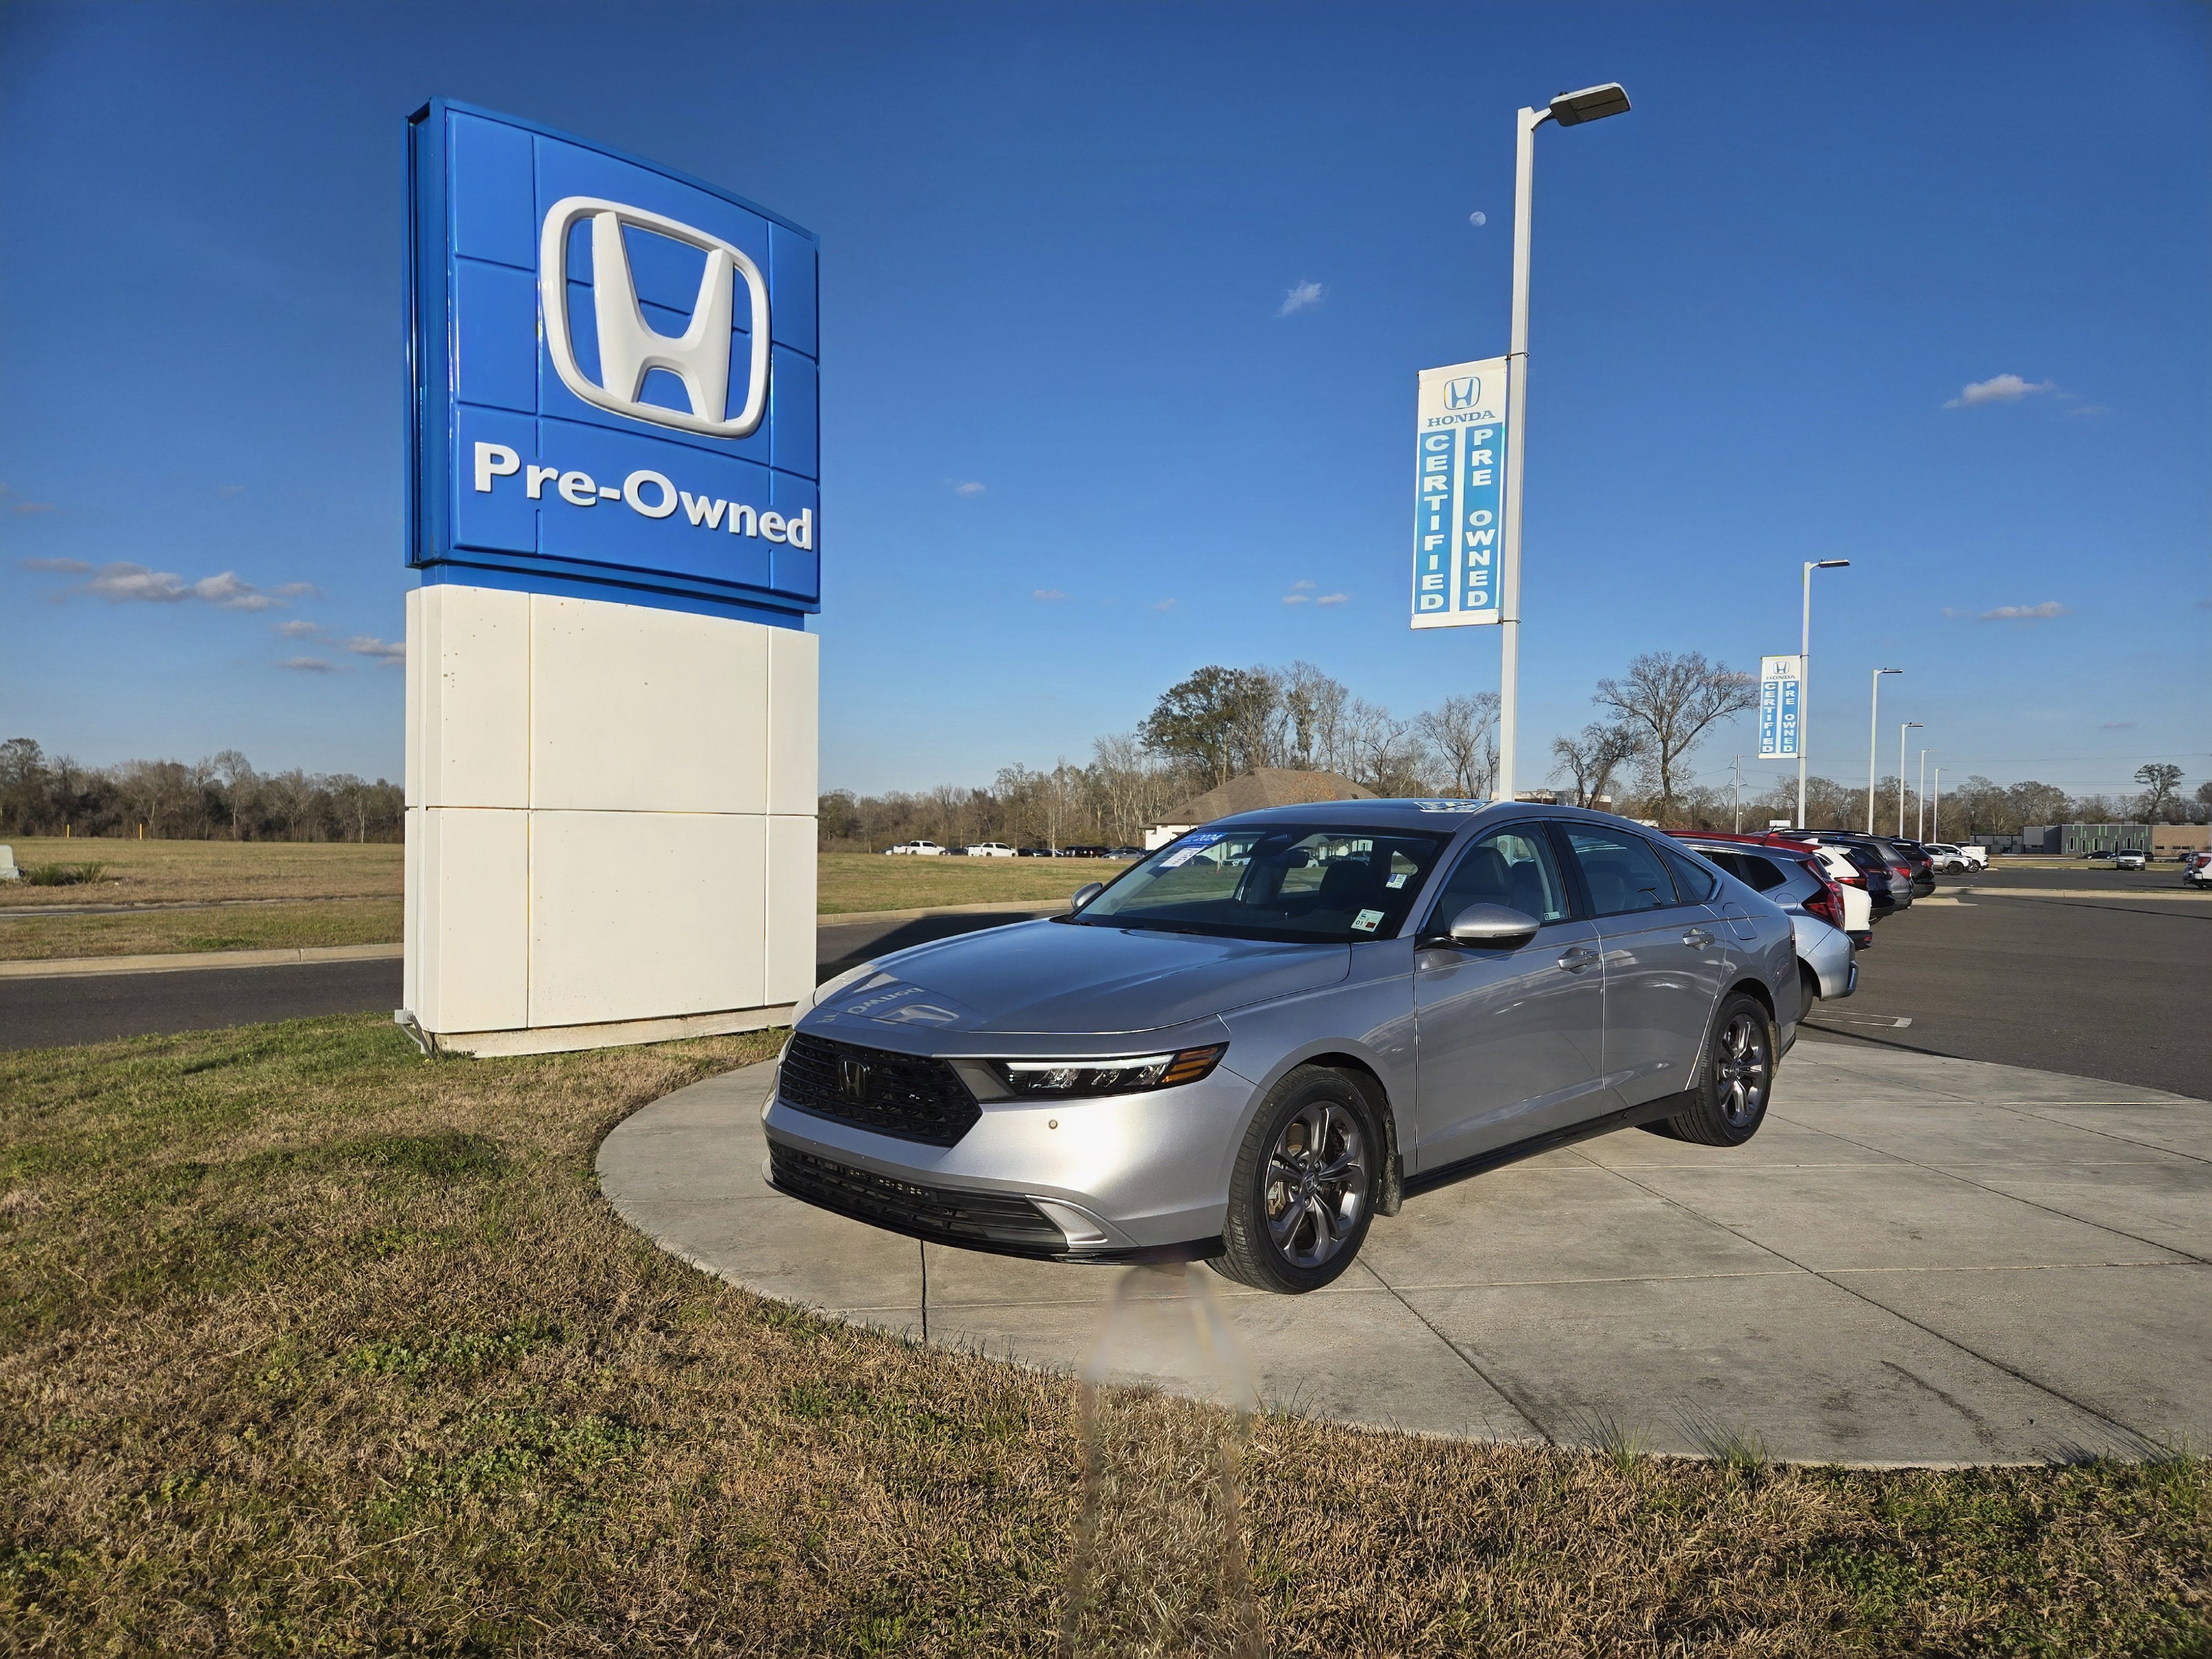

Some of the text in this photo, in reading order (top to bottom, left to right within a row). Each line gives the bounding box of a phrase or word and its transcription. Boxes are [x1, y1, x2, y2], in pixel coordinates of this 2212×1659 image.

[1427, 410, 1495, 426] HONDA
[474, 441, 813, 551] Pre-Owned
[1421, 435, 1449, 610] CERTIFIED
[1465, 428, 1496, 608] PRE OWNED
[1762, 682, 1776, 753] CERTIFIED
[1783, 682, 1796, 752] PRE OWNED
